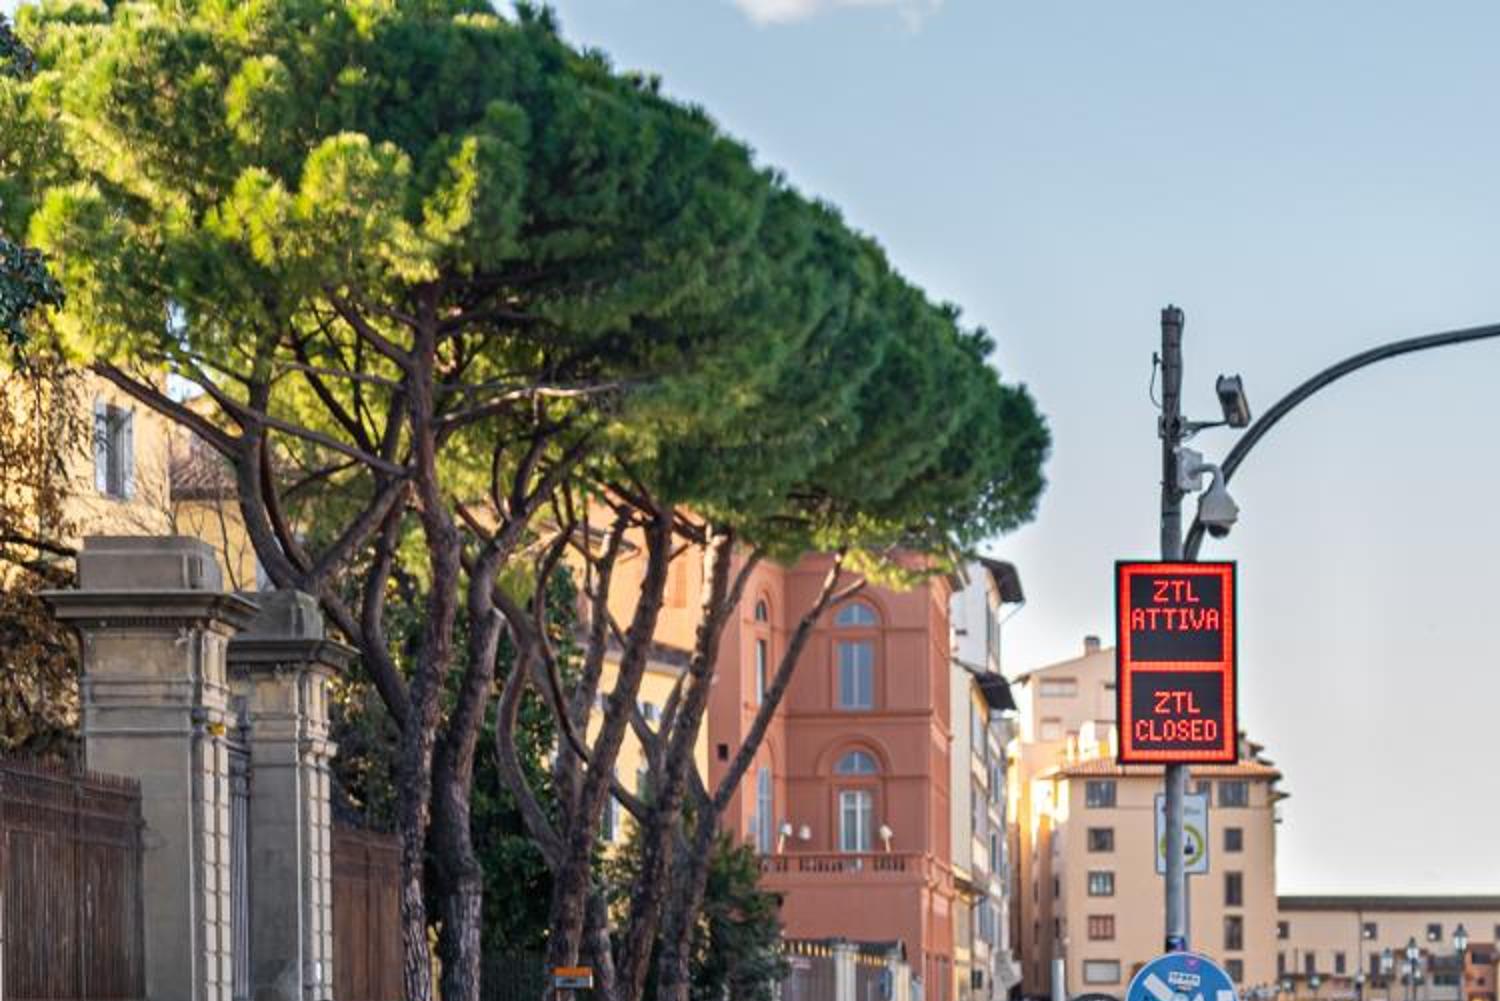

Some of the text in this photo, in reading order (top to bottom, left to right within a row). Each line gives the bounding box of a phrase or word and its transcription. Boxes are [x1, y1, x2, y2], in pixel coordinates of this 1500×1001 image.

[1153, 580, 1199, 603] ZTL
[1131, 607, 1219, 630] ATTIVA
[1154, 691, 1200, 714] ZTL
[1135, 719, 1217, 741] CLOSED
